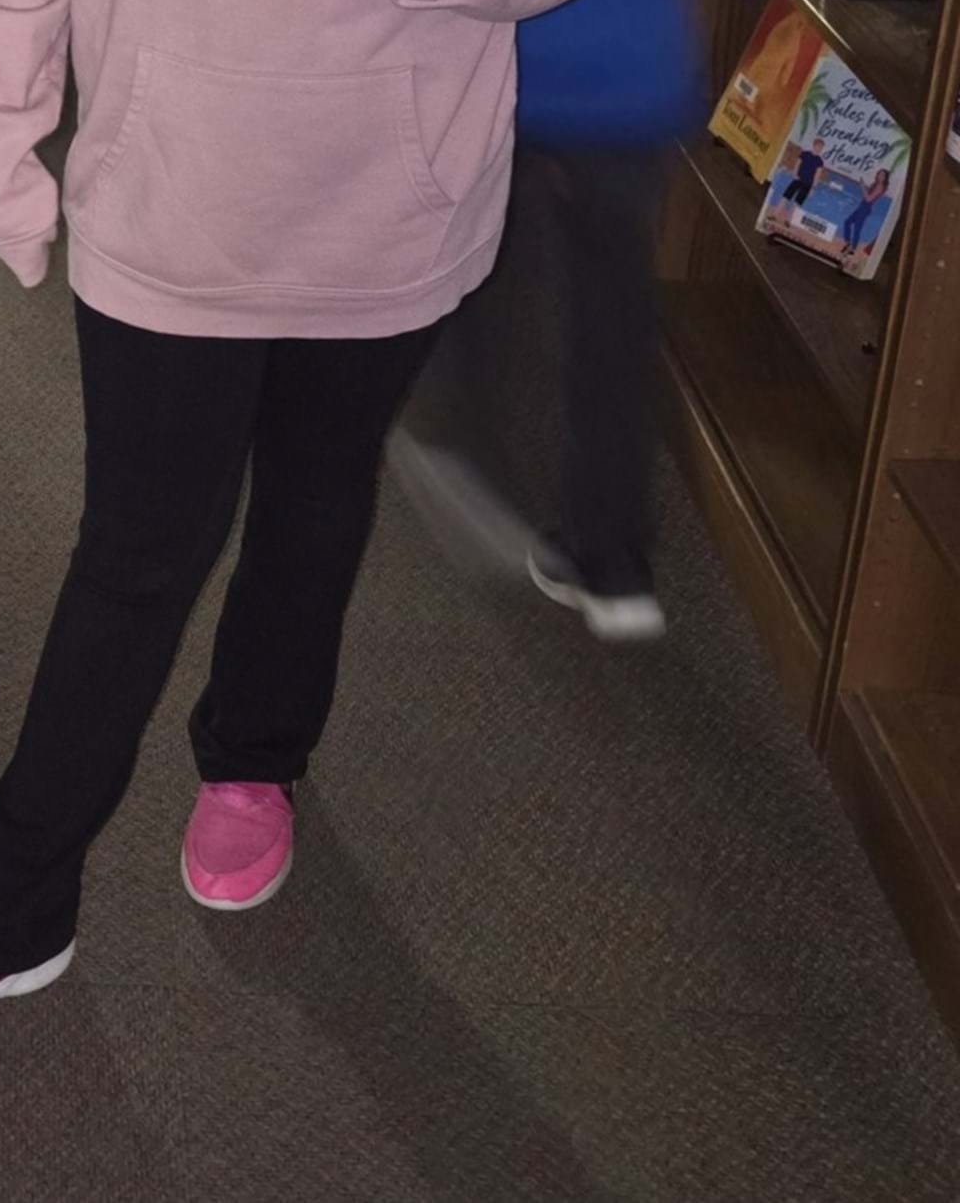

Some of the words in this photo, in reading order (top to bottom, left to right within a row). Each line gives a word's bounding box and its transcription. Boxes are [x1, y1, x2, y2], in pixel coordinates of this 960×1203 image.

[822, 98, 865, 123] Rules
[818, 119, 890, 159] Breaking
[823, 143, 875, 172] Hearts
